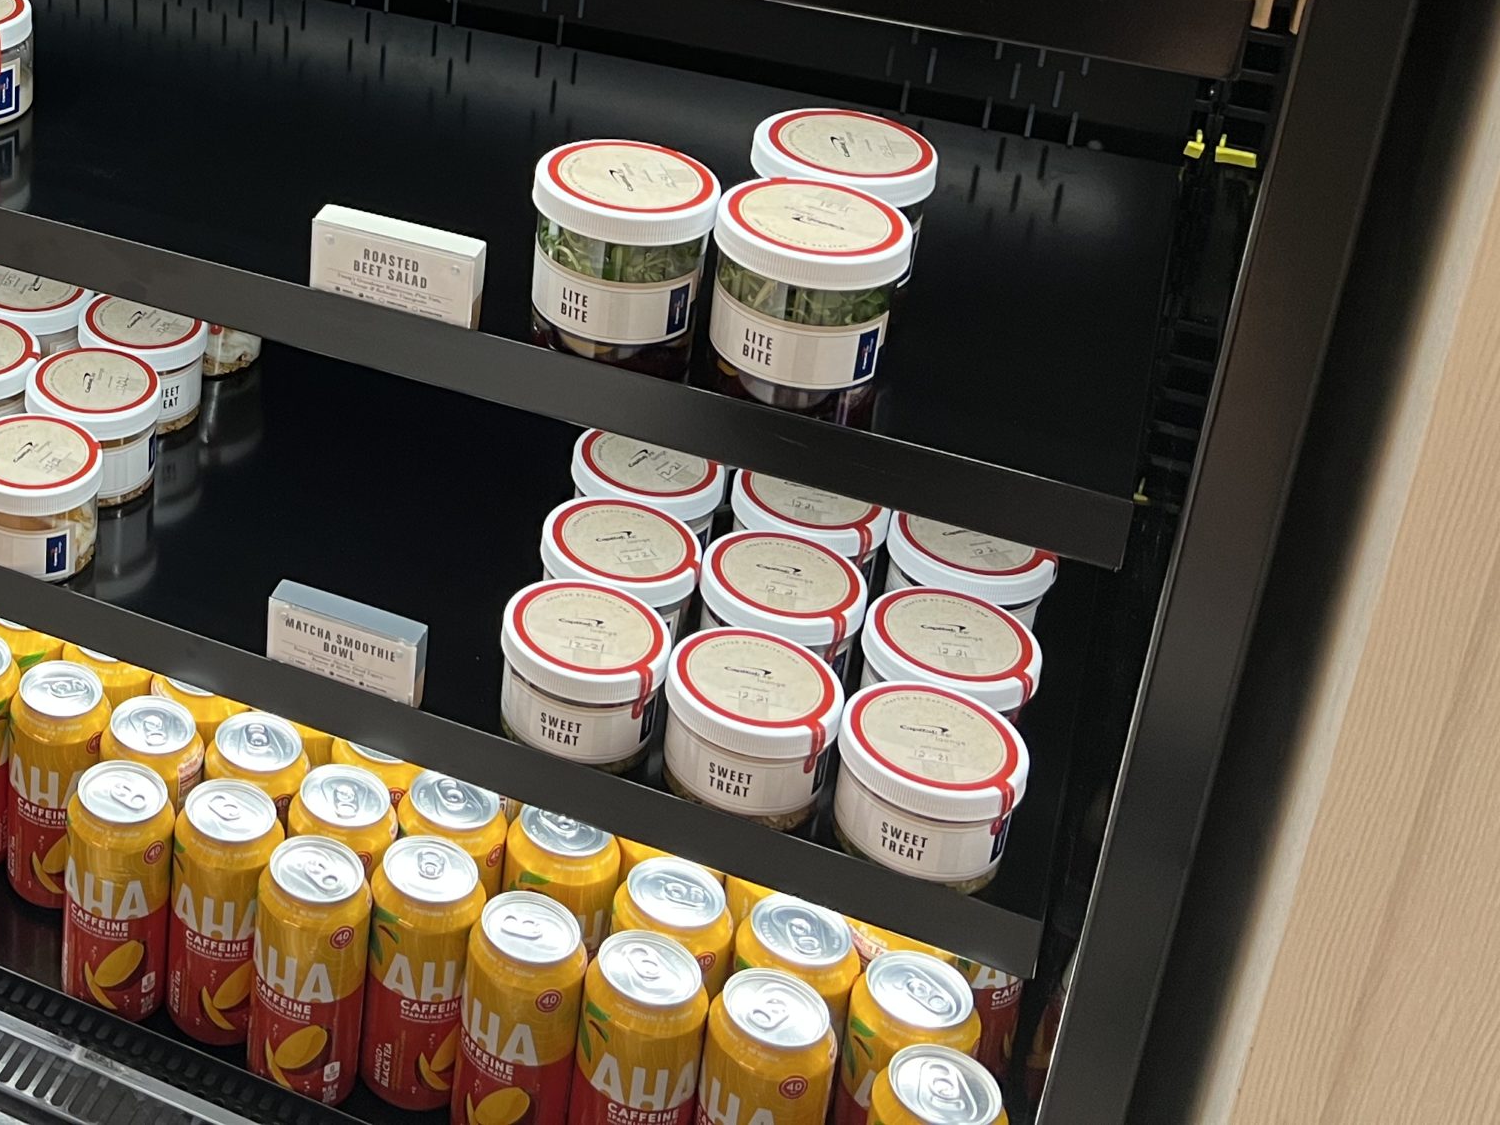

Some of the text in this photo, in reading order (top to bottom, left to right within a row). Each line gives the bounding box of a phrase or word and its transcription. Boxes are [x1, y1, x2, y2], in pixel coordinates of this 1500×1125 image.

[364, 248, 419, 273] ROASTED
[354, 259, 428, 289] BEET SALAD
[562, 287, 588, 309] LITE
[560, 302, 588, 323] BITE
[745, 327, 773, 351] LITE
[742, 345, 772, 367] BITE
[286, 617, 396, 663] MATCHA SMOOTHIE
[323, 641, 354, 661] BOWL
[540, 711, 582, 735] SWEET
[540, 725, 579, 747] TREAT
[708, 761, 752, 786] SWEET
[710, 775, 749, 798] TREAT
[17, 798, 66, 820] CAFFEIN
[880, 821, 928, 849] SWEET
[881, 837, 924, 862] TREAT
[64, 855, 149, 920] AHA
[71, 904, 128, 932] CAFFEINE
[174, 883, 256, 941] AHA
[186, 930, 248, 953] CAFFEINE
[335, 931, 350, 942] 40
[254, 929, 334, 1004] AHA
[255, 978, 312, 1015] CAFFEINE
[400, 999, 460, 1013] CAFFEIN
[542, 995, 557, 1007] 40
[590, 1054, 699, 1111] AHA
[786, 1082, 801, 1093] 40
[608, 1103, 679, 1122] CAFFEINE
